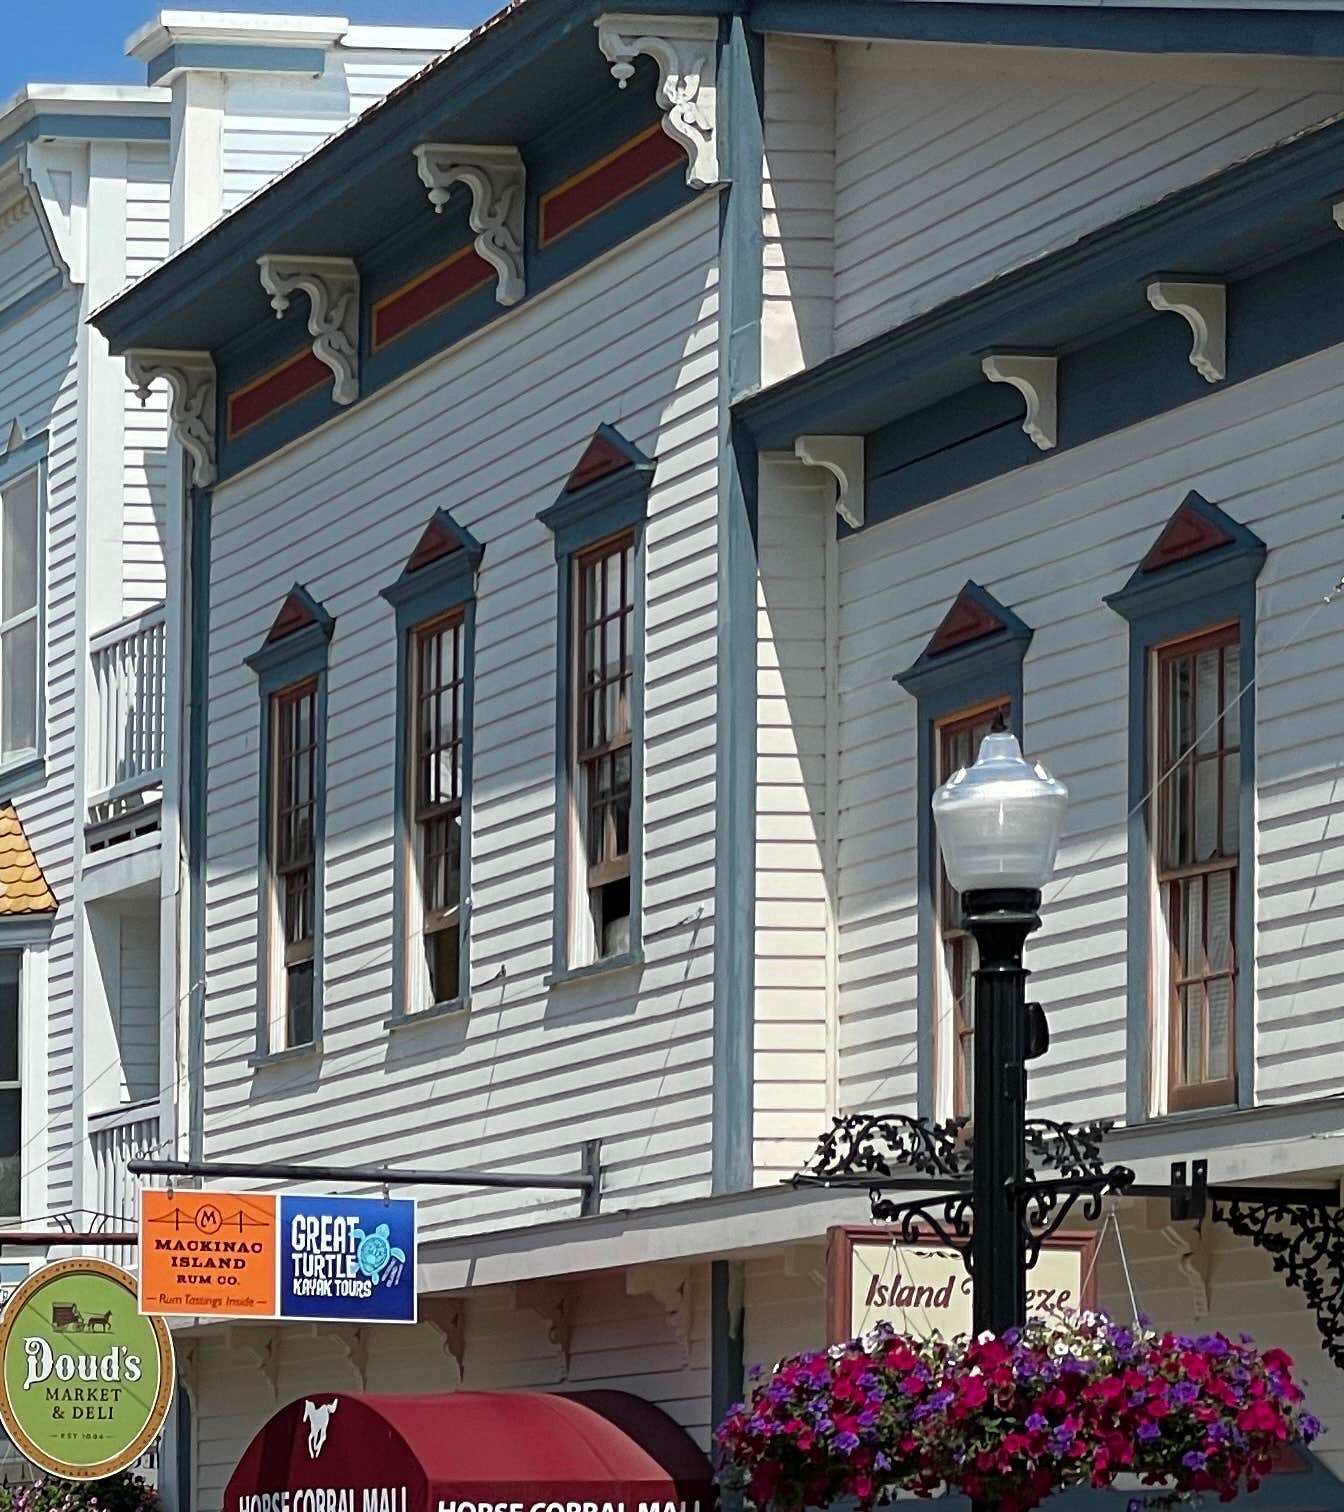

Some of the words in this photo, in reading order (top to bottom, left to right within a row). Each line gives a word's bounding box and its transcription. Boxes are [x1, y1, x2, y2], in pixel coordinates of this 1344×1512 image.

[292, 1214, 359, 1252] GREAT
[155, 1239, 262, 1253] MACKINAC
[171, 1256, 246, 1269] ISLAND
[292, 1253, 356, 1279] TURTLE
[176, 1274, 212, 1285] RUM
[217, 1275, 240, 1285] CO.
[293, 1279, 332, 1297] KAYAK
[334, 1280, 372, 1298] TOURS
[865, 1274, 956, 1308] Island
[159, 1293, 182, 1304] Rum
[23, 1336, 142, 1390] Doud's
[46, 1388, 122, 1401] MARKET
[52, 1406, 64, 1419] &
[72, 1406, 114, 1419] DELI
